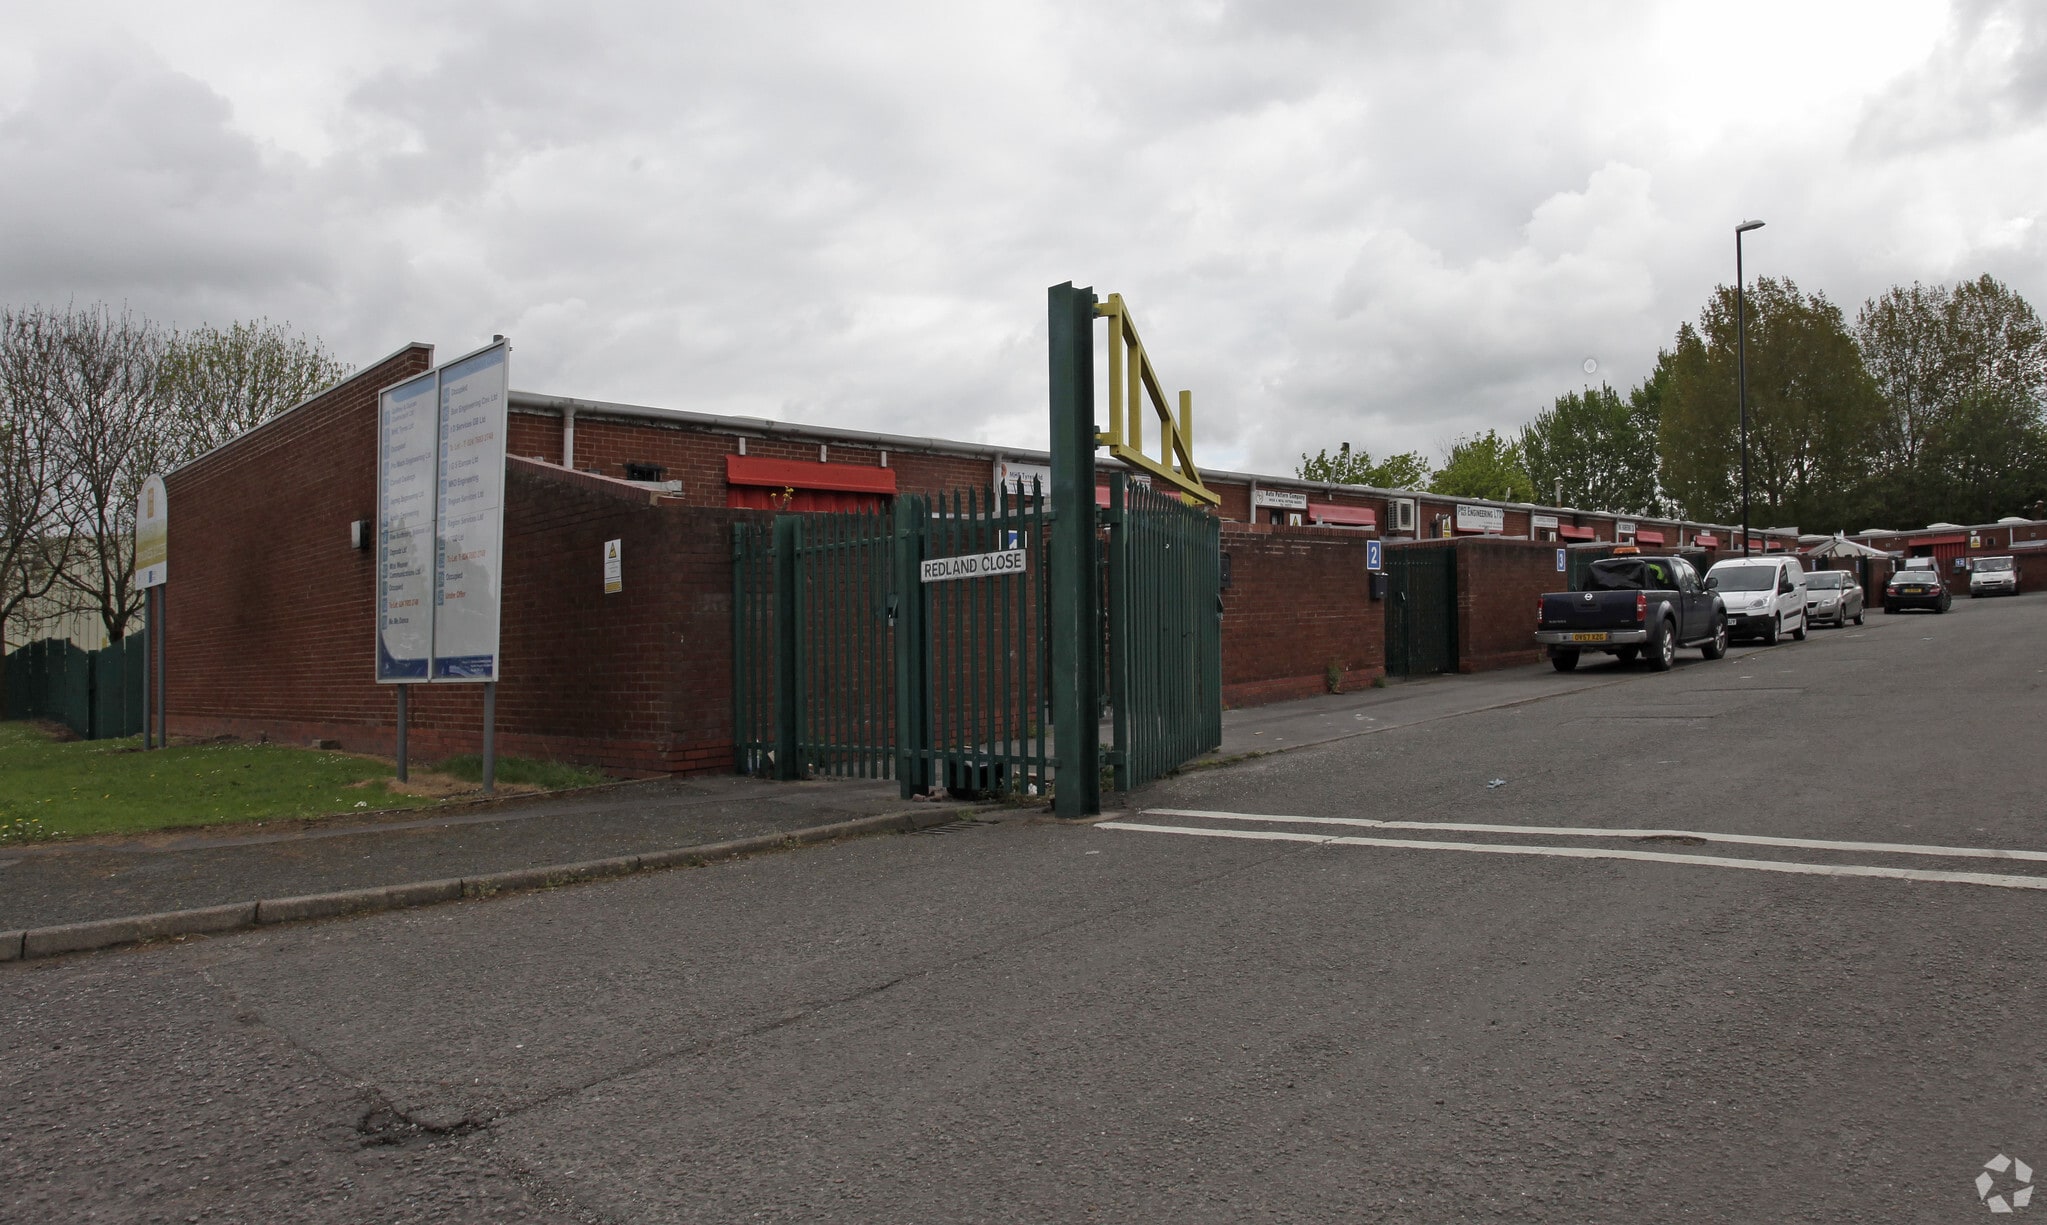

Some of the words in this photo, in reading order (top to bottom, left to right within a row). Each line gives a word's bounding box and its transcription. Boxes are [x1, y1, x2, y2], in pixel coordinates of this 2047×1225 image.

[1370, 546, 1377, 564] 2
[1559, 553, 1564, 568] 3
[924, 558, 978, 578] REDLAND
[981, 553, 1022, 572] CLOSE
